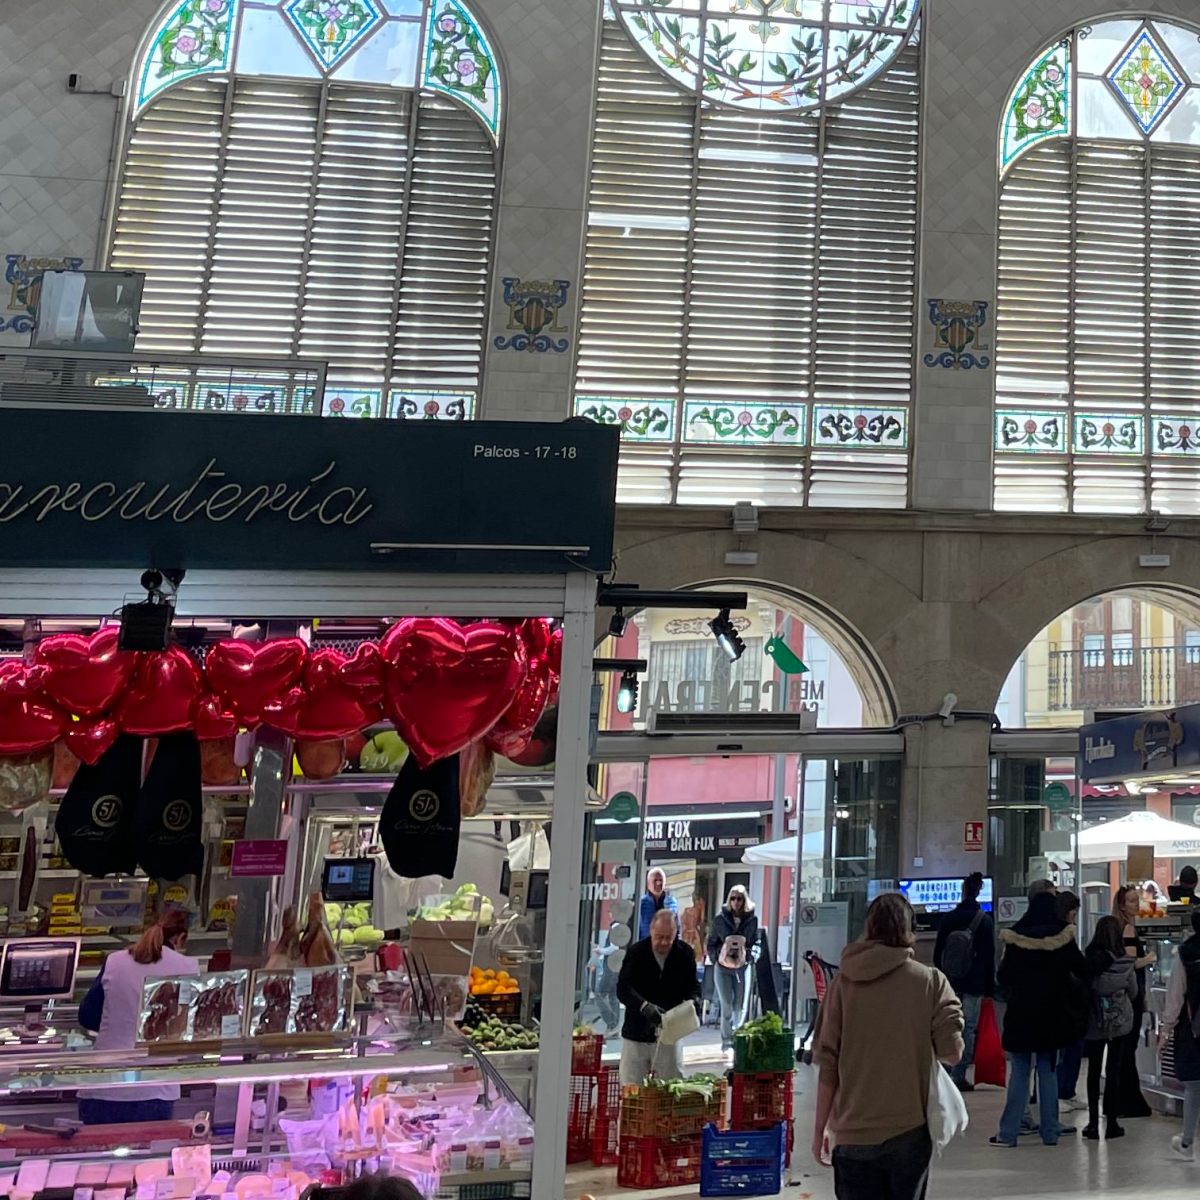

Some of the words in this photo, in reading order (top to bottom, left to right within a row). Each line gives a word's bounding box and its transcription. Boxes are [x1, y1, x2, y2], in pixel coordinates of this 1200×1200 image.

[474, 445, 520, 458] Palcos
[535, 446, 551, 459] 17
[667, 821, 691, 838] FOX
[1172, 840, 1200, 849] AMSTEL
